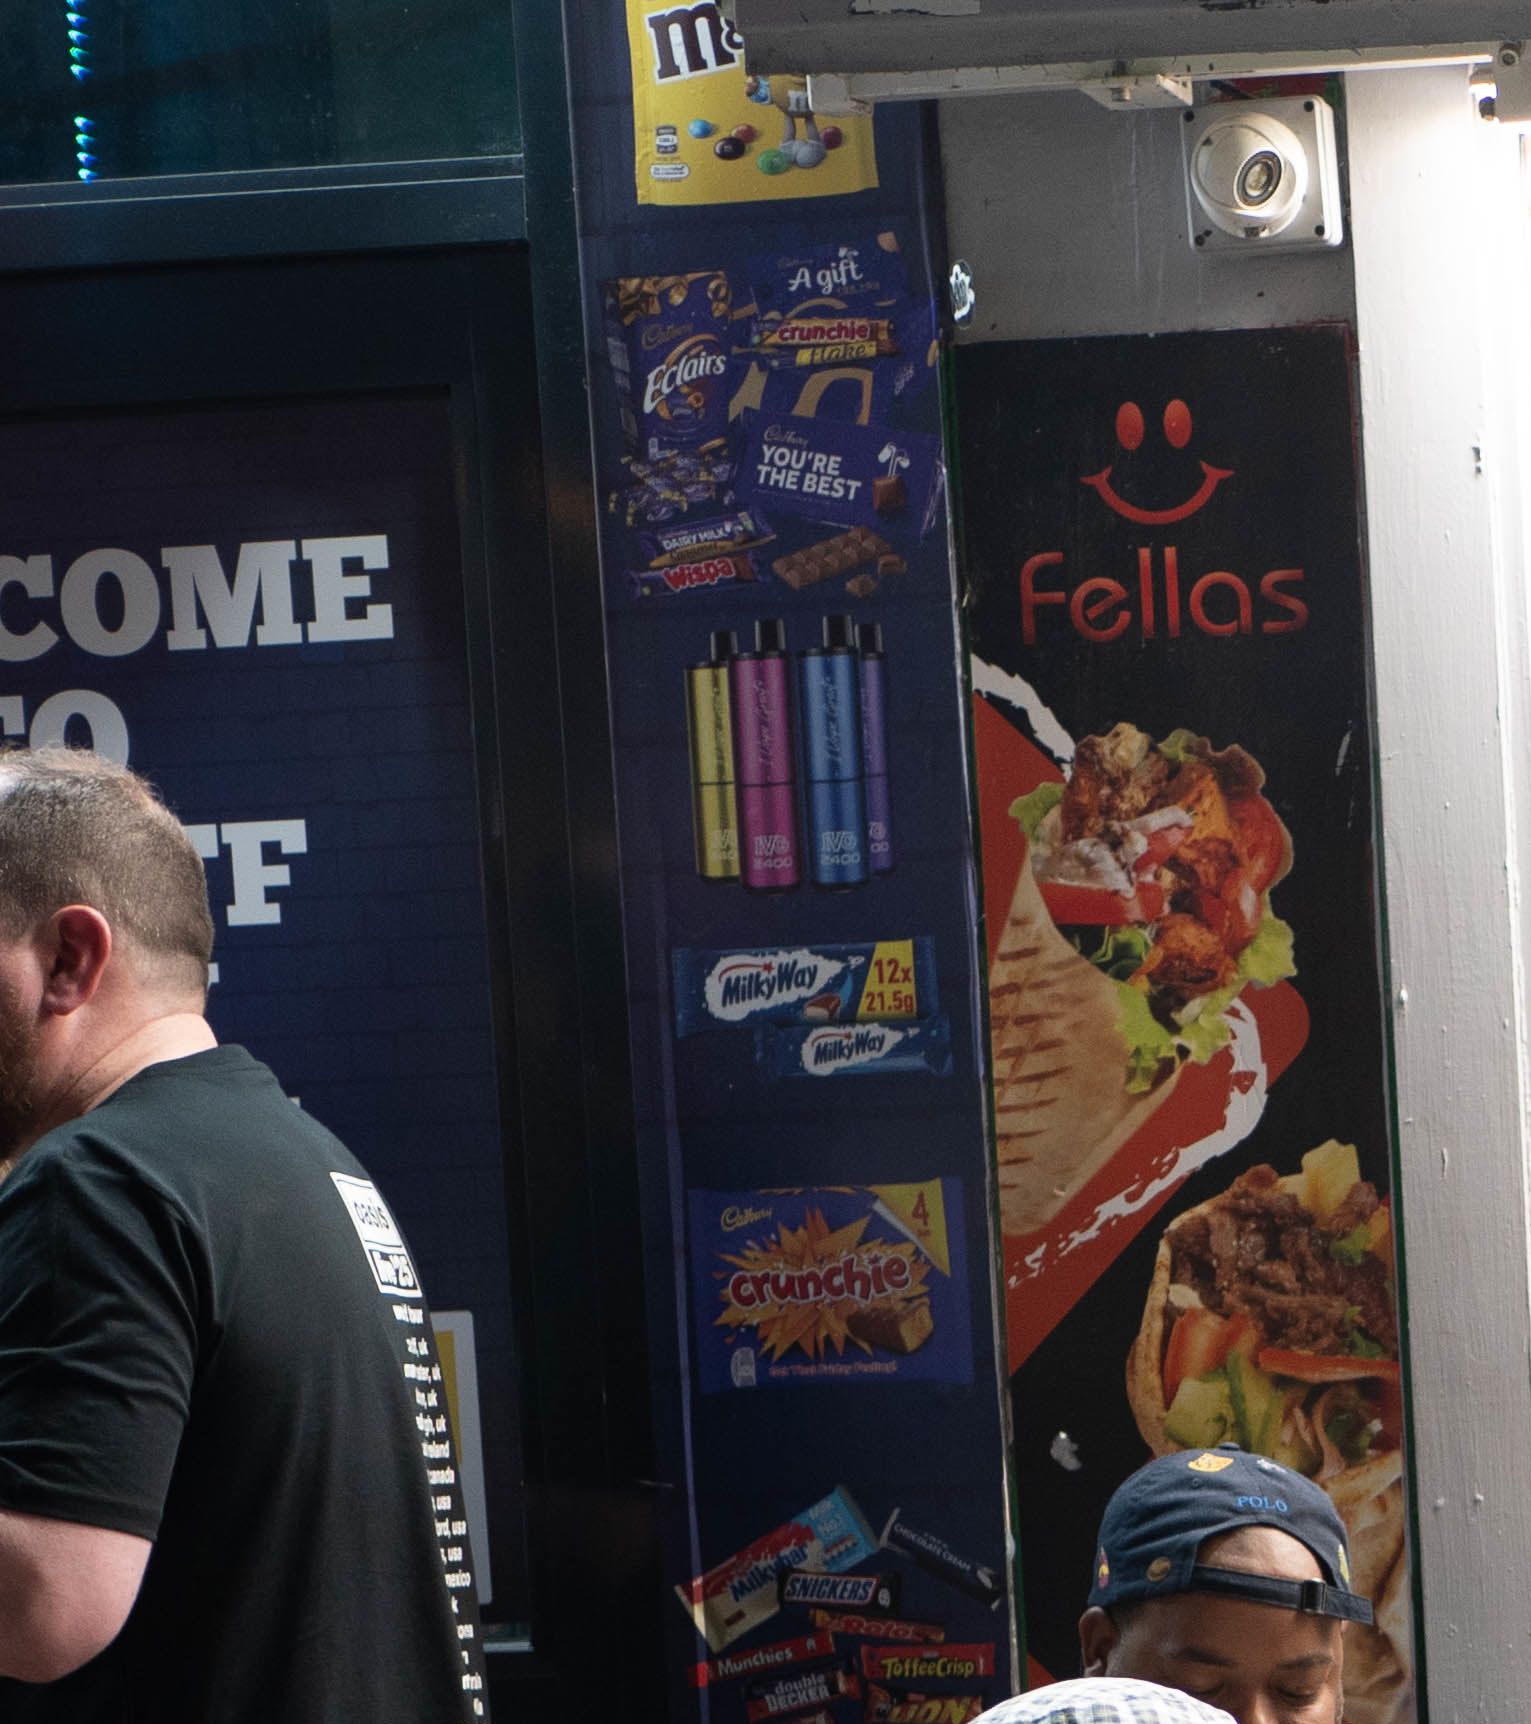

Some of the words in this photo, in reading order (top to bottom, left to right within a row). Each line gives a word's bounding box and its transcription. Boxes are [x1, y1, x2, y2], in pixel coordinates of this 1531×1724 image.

[787, 267, 811, 292] A
[815, 256, 864, 295] gift
[776, 321, 874, 343] crunchie
[643, 351, 727, 414] Eclairs
[761, 445, 842, 475] YOU'RE
[757, 464, 800, 492] THE
[802, 473, 862, 500] BEST
[662, 534, 699, 551] DAIRY
[699, 527, 726, 545] MILK
[661, 557, 736, 593] wispa
[873, 958, 912, 986] 12x
[866, 990, 913, 1012] 21.5g
[354, 1196, 390, 1230] oasis
[910, 1190, 930, 1227] 4
[728, 1253, 912, 1309] crunchie
[1236, 1495, 1288, 1513] POLO
[785, 1574, 876, 1601] SNICKERS
[717, 1646, 794, 1678] Munchies
[774, 1671, 826, 1695] double
